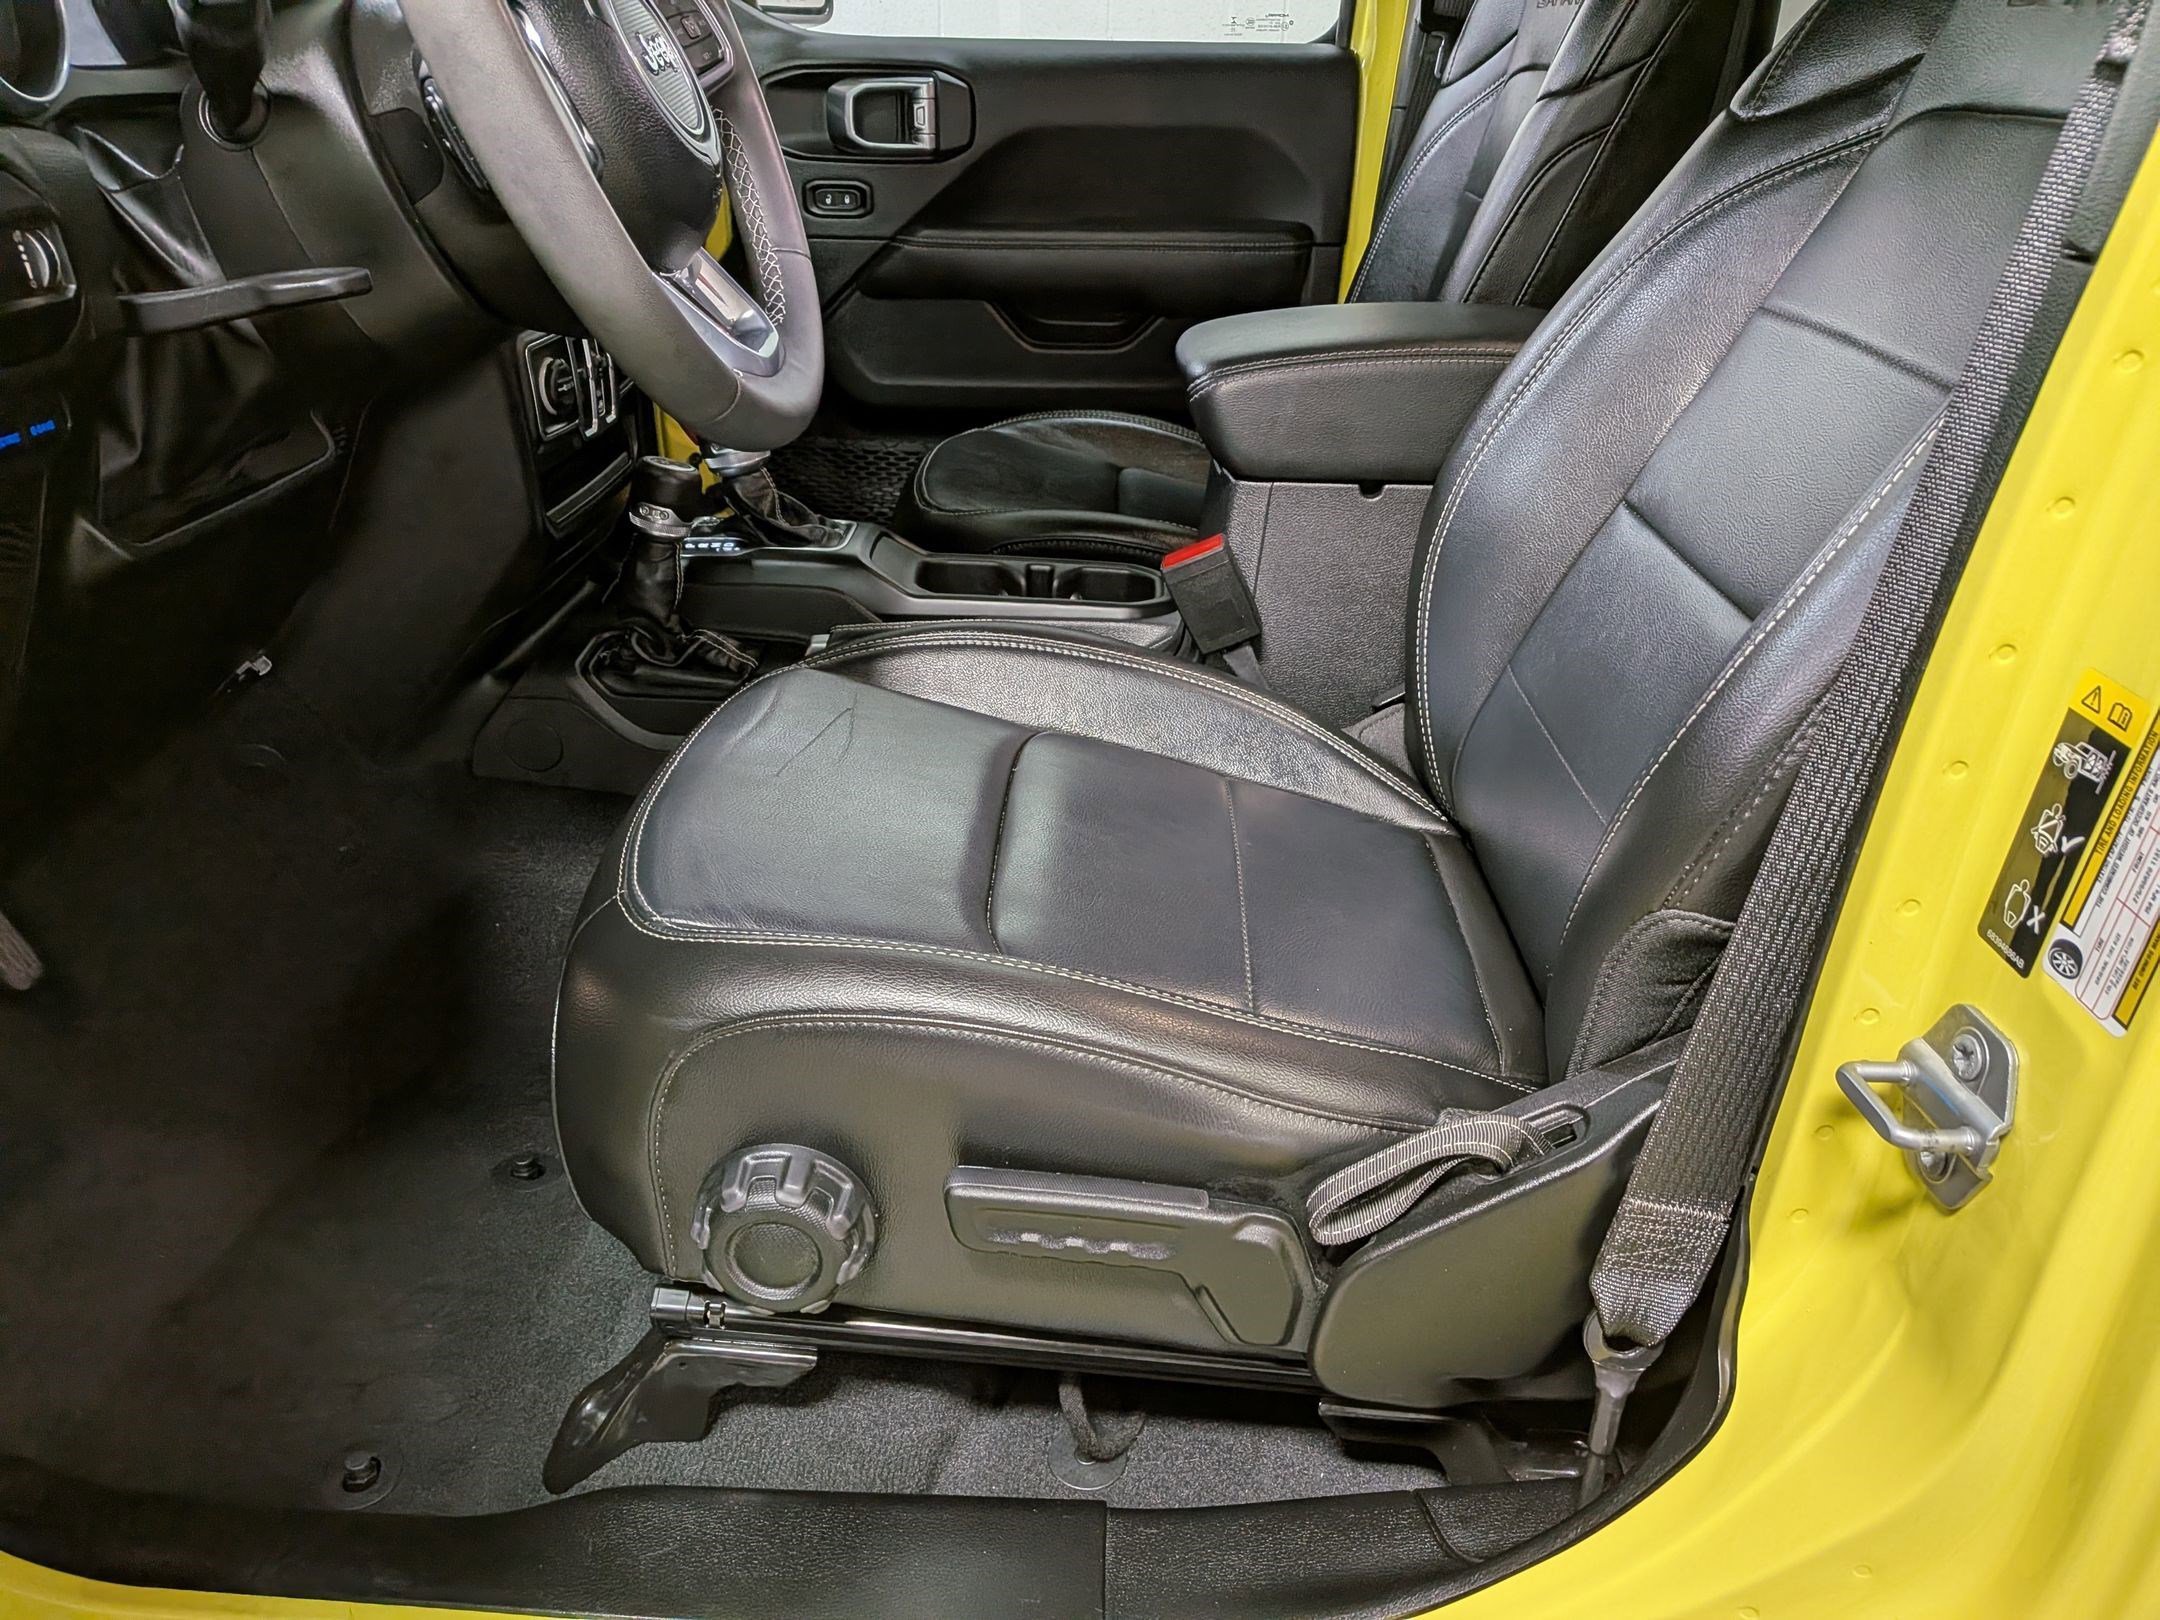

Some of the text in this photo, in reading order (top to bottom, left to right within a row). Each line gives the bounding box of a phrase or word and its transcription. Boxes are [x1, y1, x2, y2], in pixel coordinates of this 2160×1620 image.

[636, 32, 678, 74] Jeep
[2095, 731, 2159, 855] TIRE AND LOADING INFORMATION
